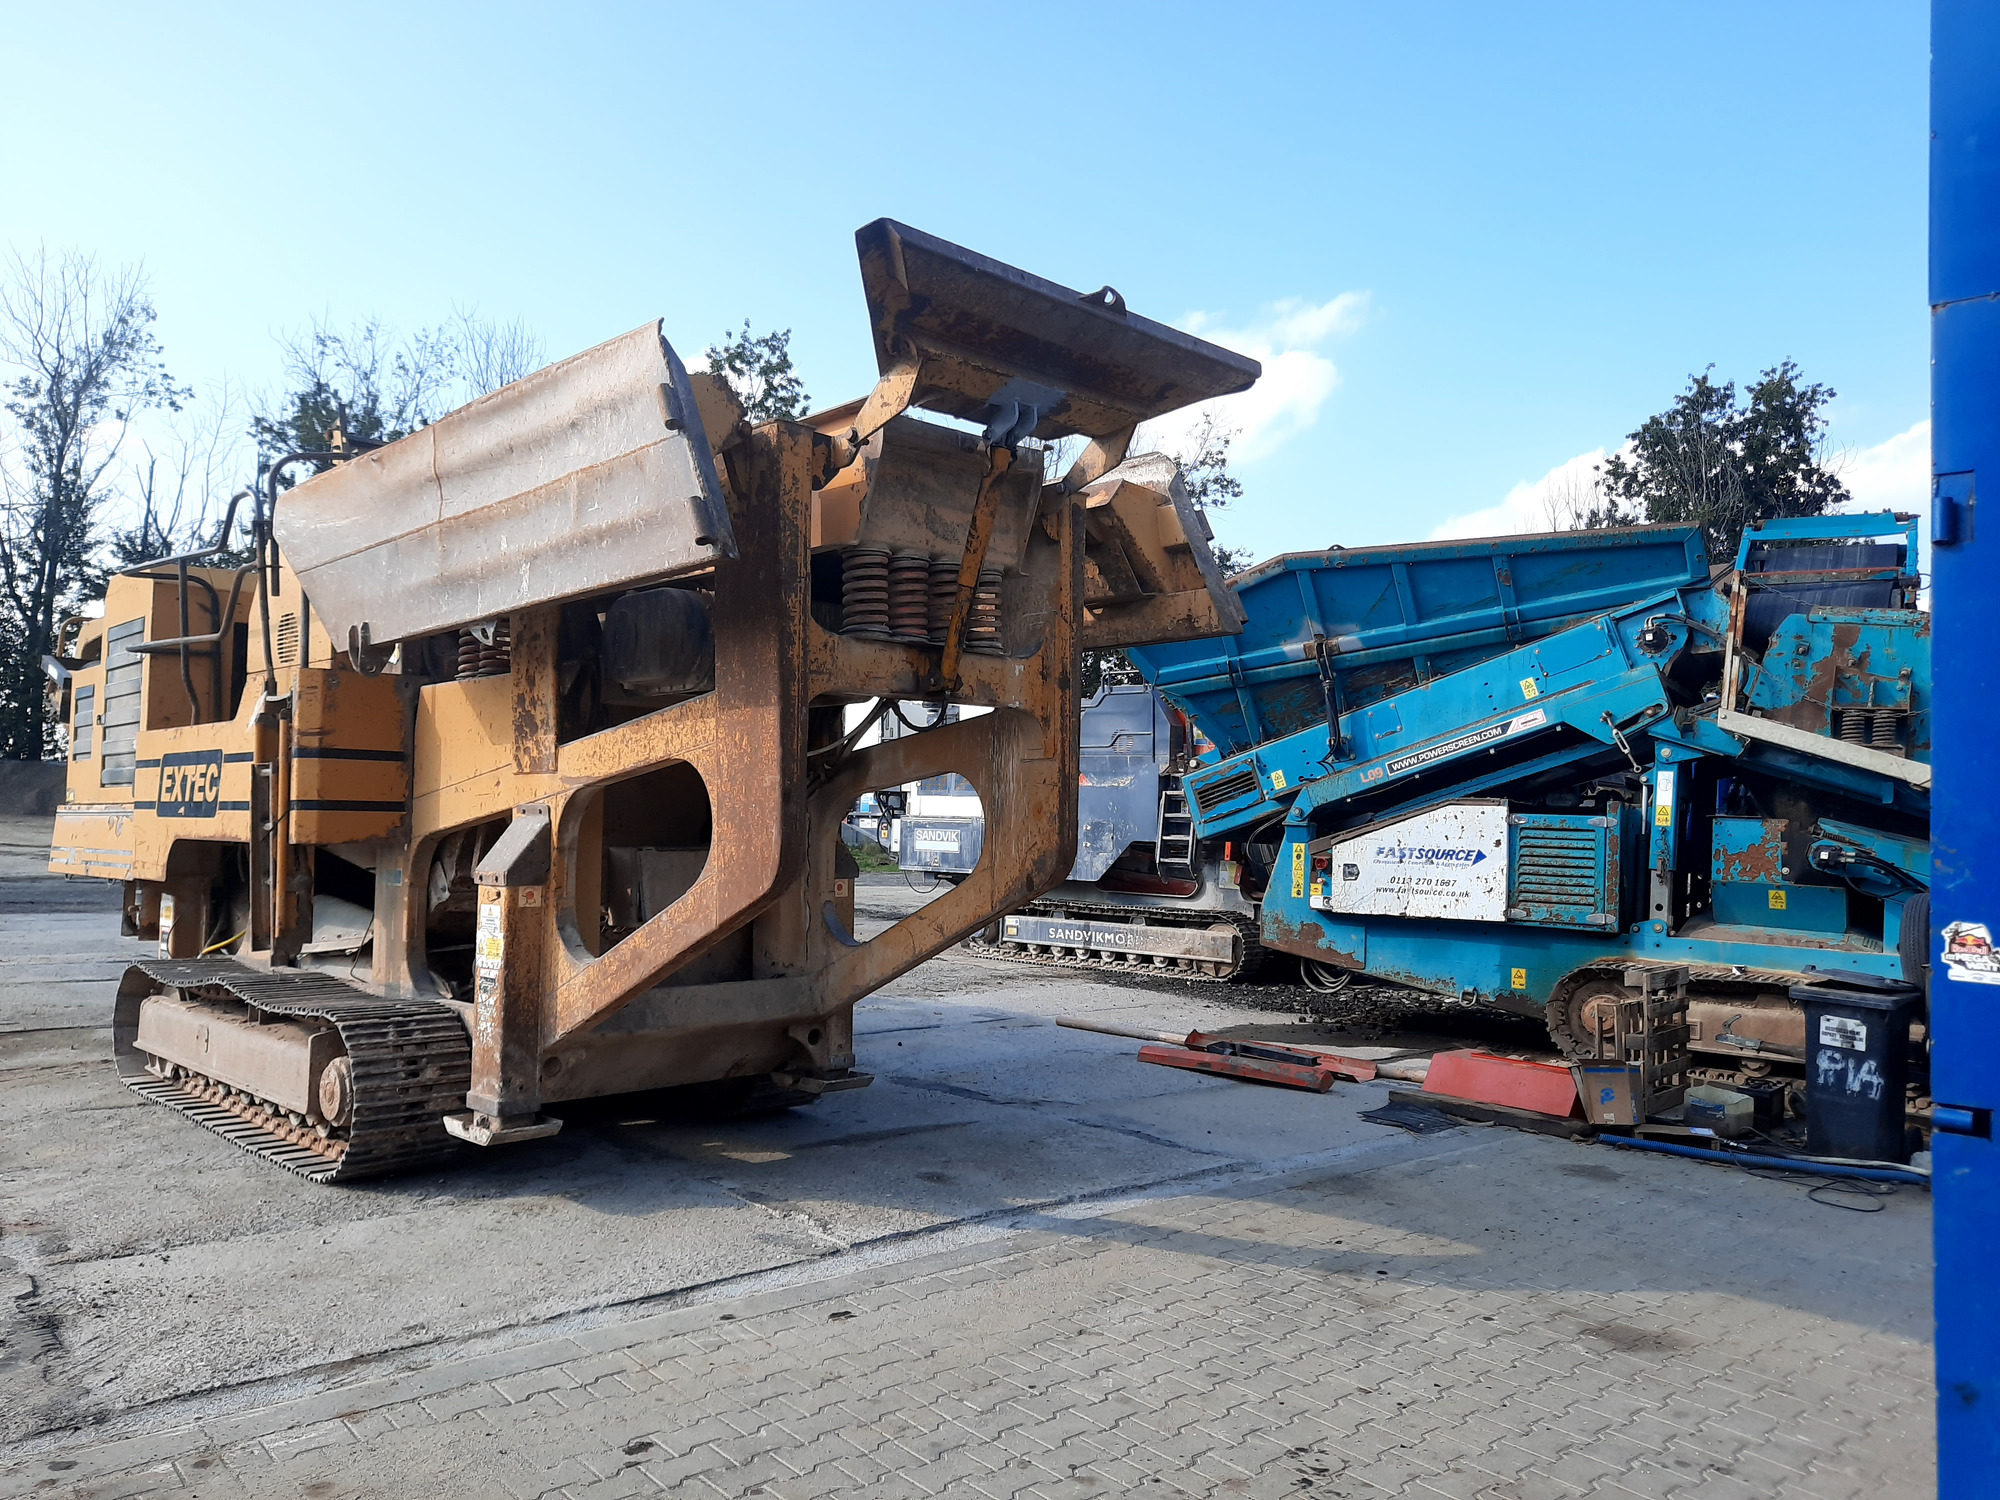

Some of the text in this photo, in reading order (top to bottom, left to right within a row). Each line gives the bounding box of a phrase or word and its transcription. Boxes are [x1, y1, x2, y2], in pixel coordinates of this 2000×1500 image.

[1391, 727, 1502, 771] WWW.POWERSCREEN.COM
[160, 763, 219, 803] EXTEC
[915, 830, 959, 842] SANDVIK
[1376, 847, 1476, 861] FASTSOURCE
[1415, 877, 1433, 887] 270
